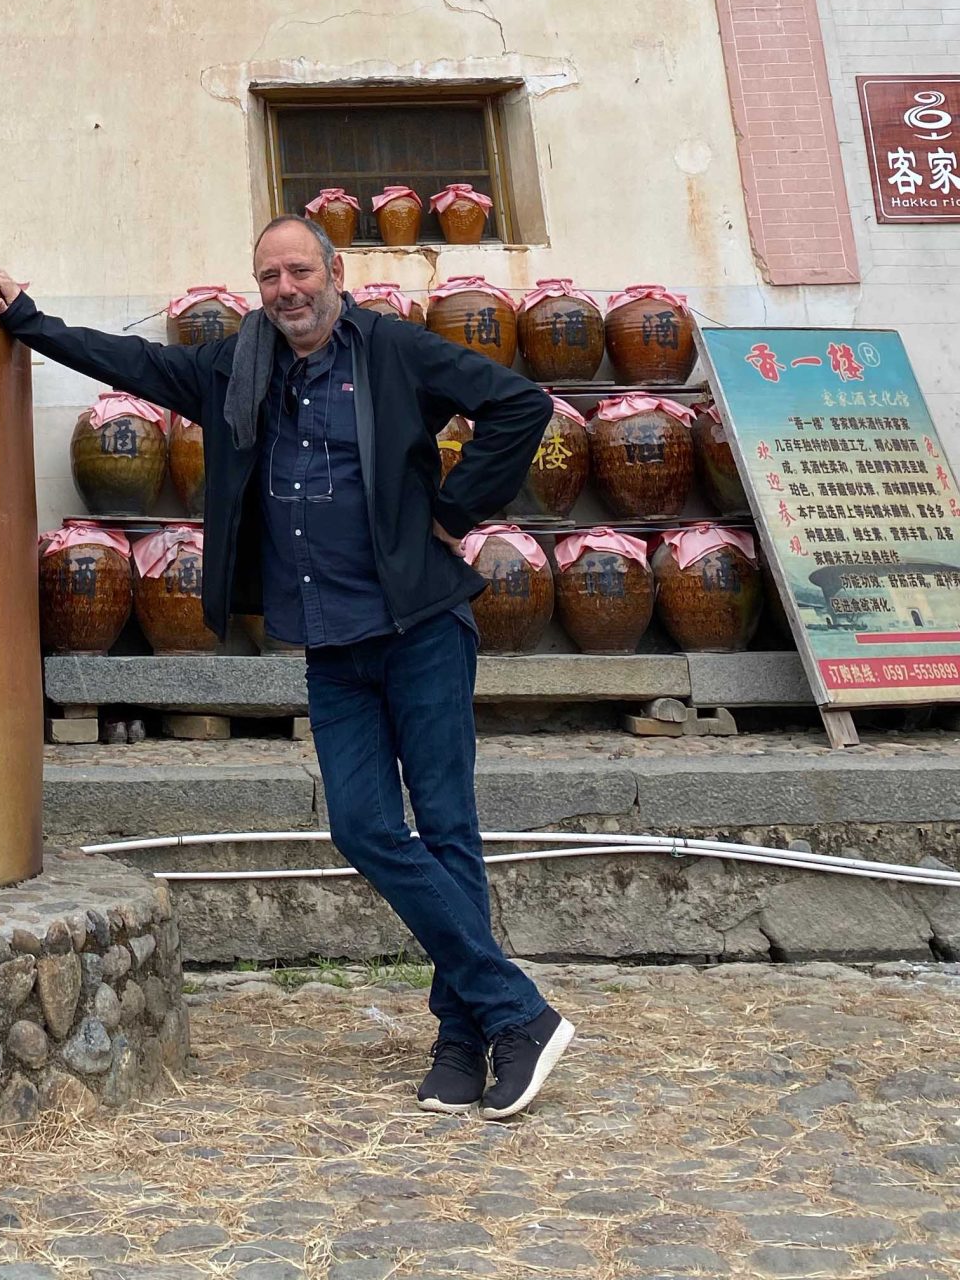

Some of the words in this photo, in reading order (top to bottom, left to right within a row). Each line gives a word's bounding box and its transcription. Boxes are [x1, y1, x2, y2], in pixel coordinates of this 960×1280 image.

[888, 146, 960, 195] 客家
[891, 197, 938, 207] Hakka
[464, 306, 501, 348] 酒
[551, 308, 589, 349] 酒
[641, 310, 679, 350] 酒
[101, 418, 139, 458] 酒
[532, 430, 572, 471] 楼
